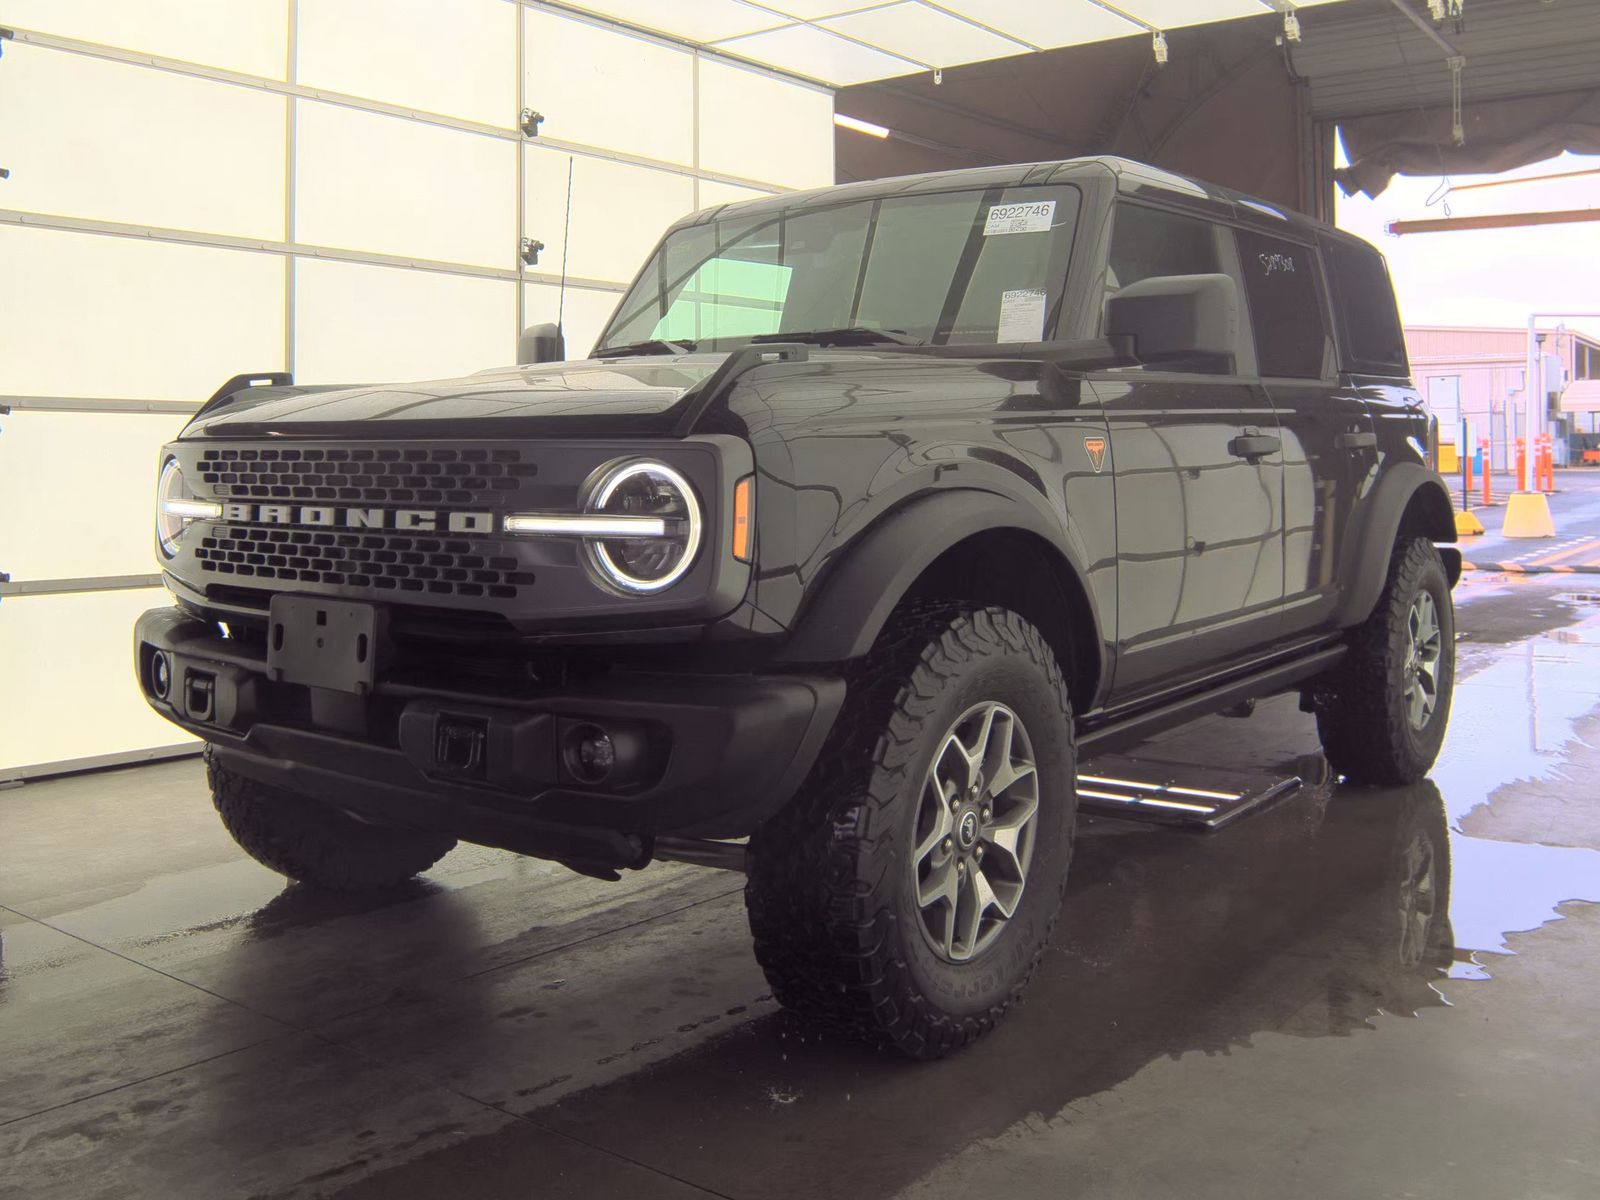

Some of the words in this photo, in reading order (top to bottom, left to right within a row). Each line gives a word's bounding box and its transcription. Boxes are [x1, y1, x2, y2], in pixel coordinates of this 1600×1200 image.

[991, 204, 1050, 220] 6922746
[1004, 288, 1048, 299] 6922746
[222, 503, 493, 533] BRONCO
